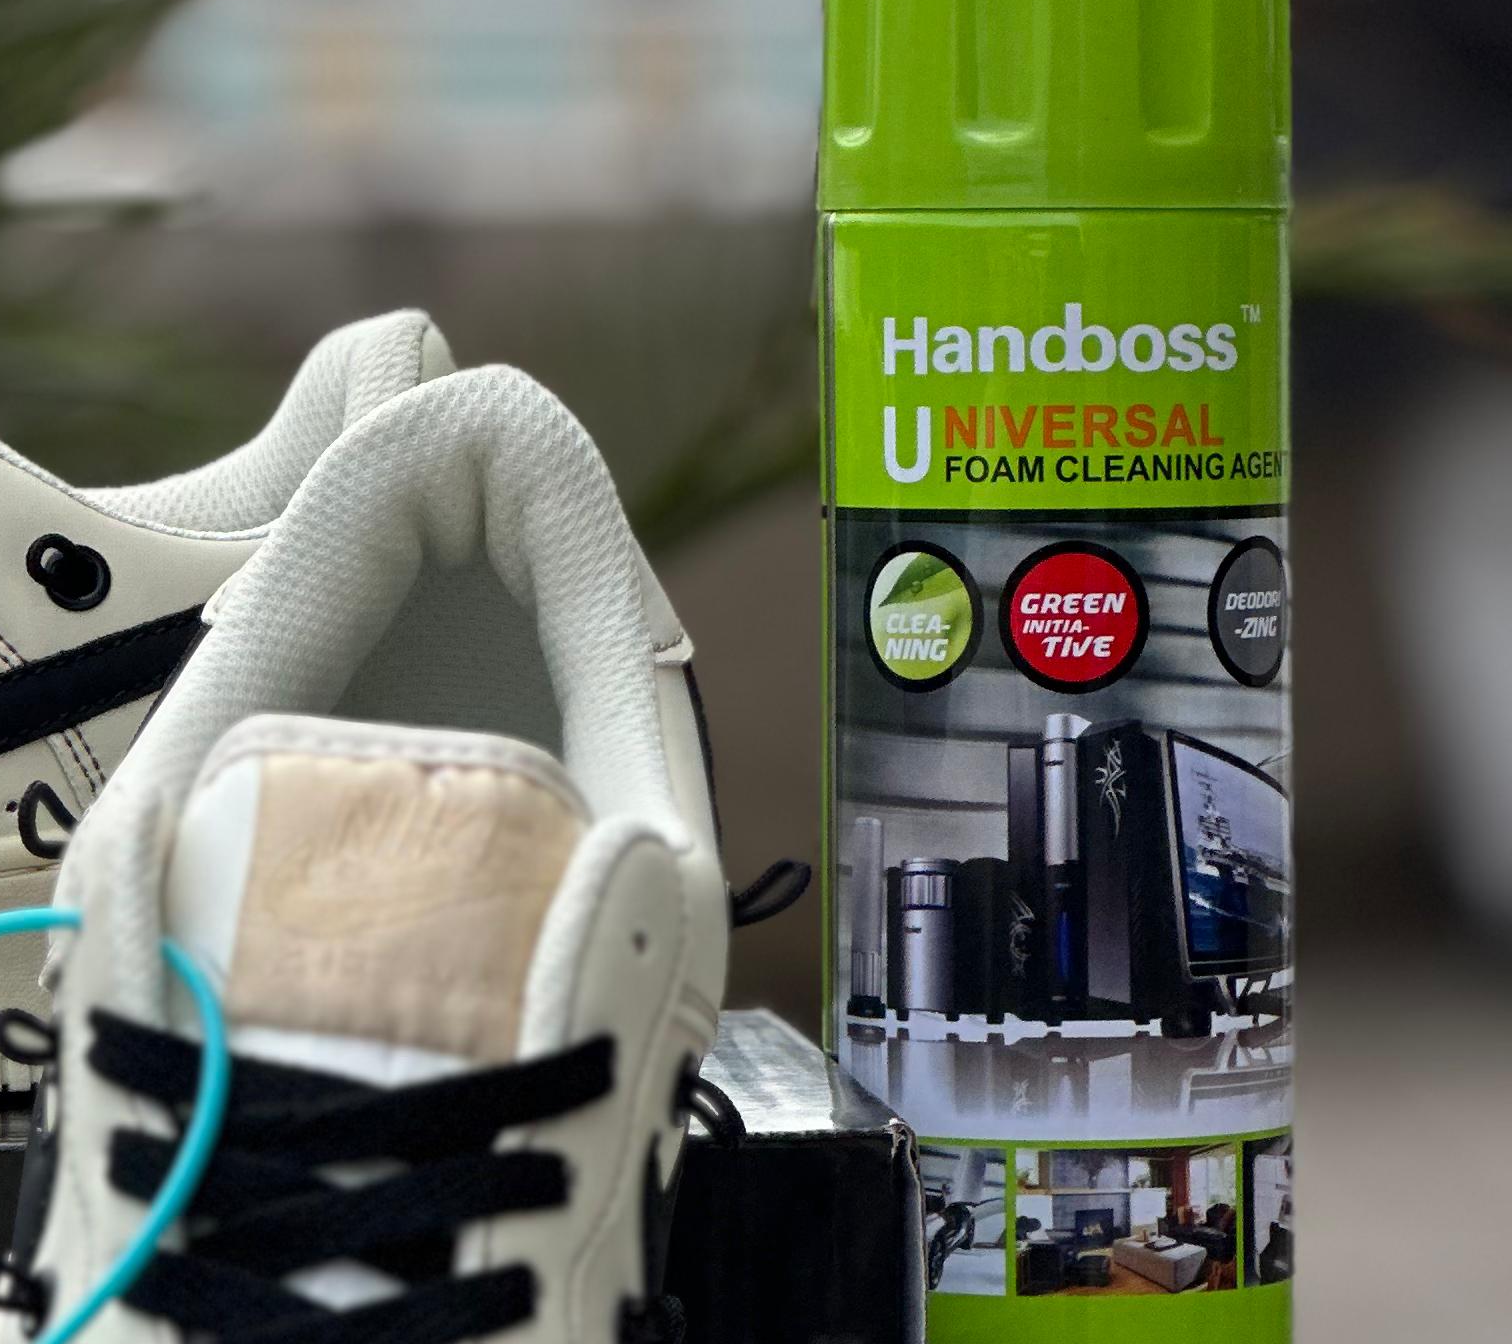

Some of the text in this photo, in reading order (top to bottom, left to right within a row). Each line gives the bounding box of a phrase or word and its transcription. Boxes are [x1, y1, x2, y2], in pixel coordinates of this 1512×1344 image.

[882, 301, 1262, 376] Handboss TM
[944, 455, 1045, 483] FOAM
[1054, 452, 1226, 482] CLEANING
[1019, 591, 1128, 615] GREEN
[885, 611, 951, 635] CLEA-
[1022, 618, 1090, 635] INITIA-
[884, 637, 949, 662] NING
